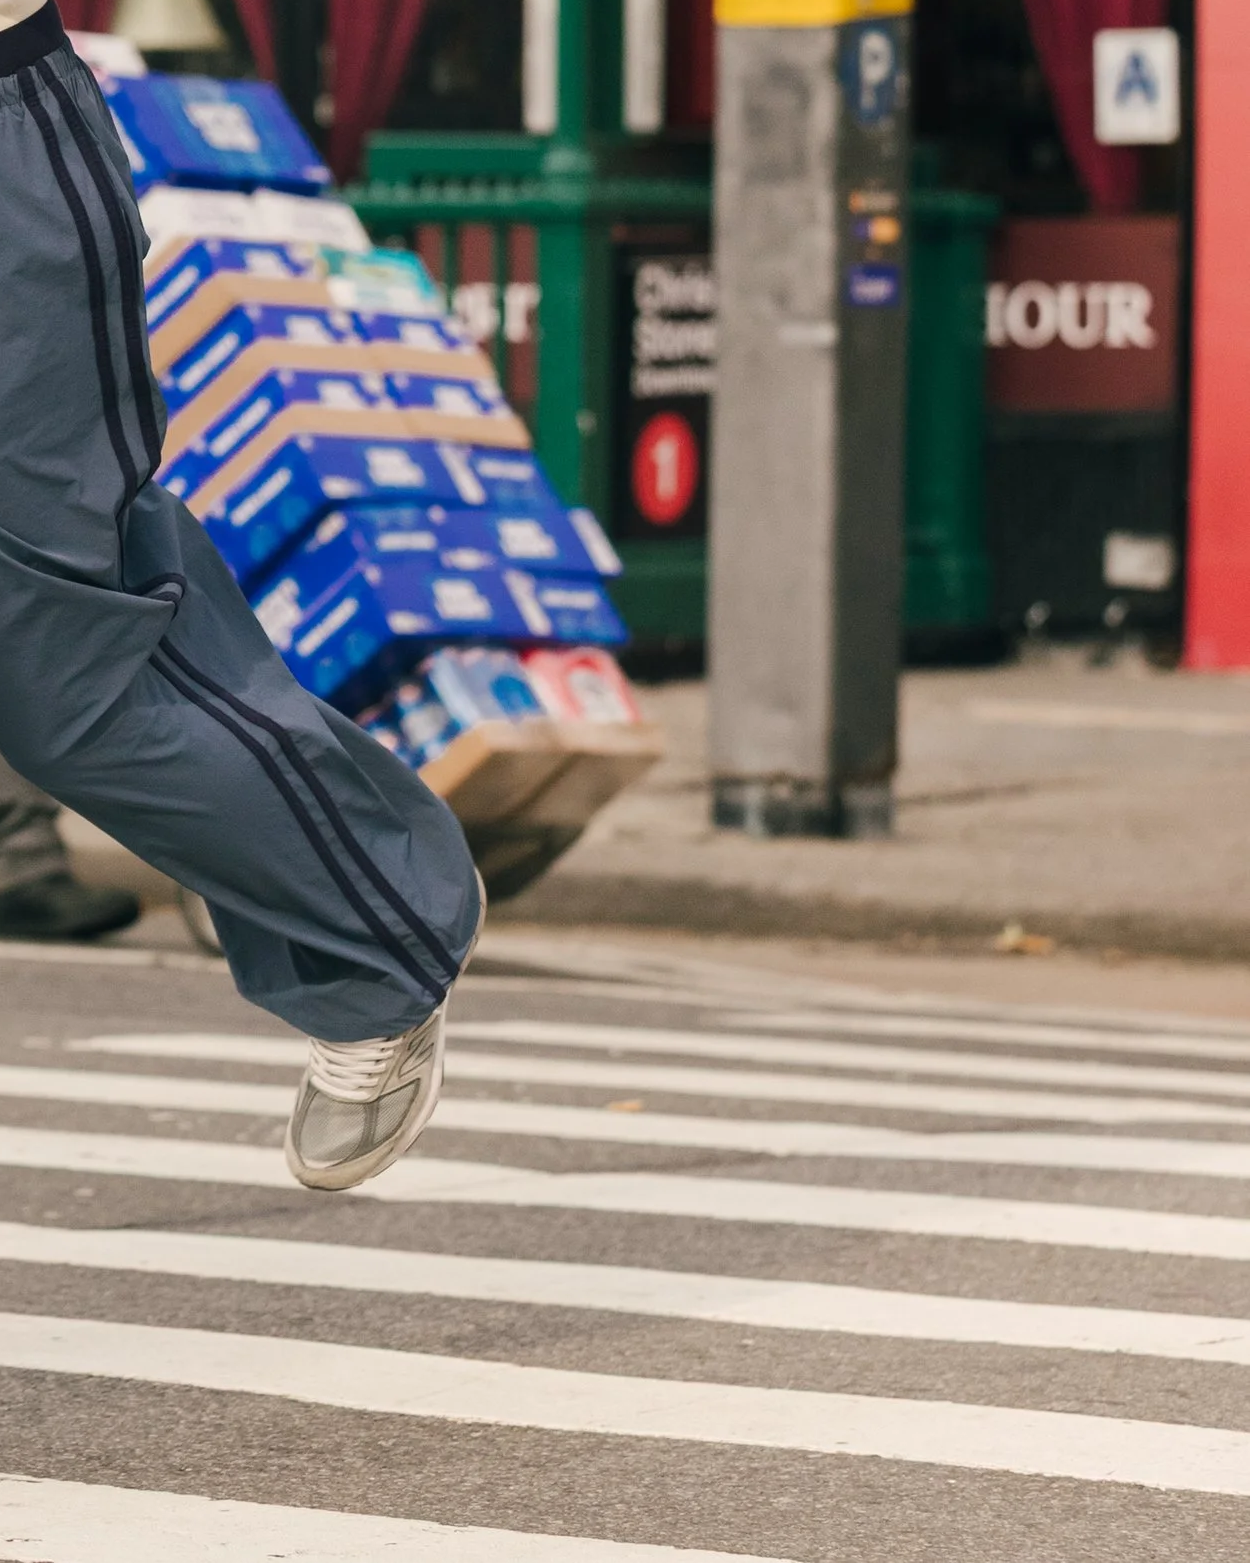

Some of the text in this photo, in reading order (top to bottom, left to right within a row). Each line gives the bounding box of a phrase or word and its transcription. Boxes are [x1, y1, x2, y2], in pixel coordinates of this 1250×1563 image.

[859, 30, 893, 109] P
[1115, 49, 1160, 106] A
[651, 435, 680, 502] 1
